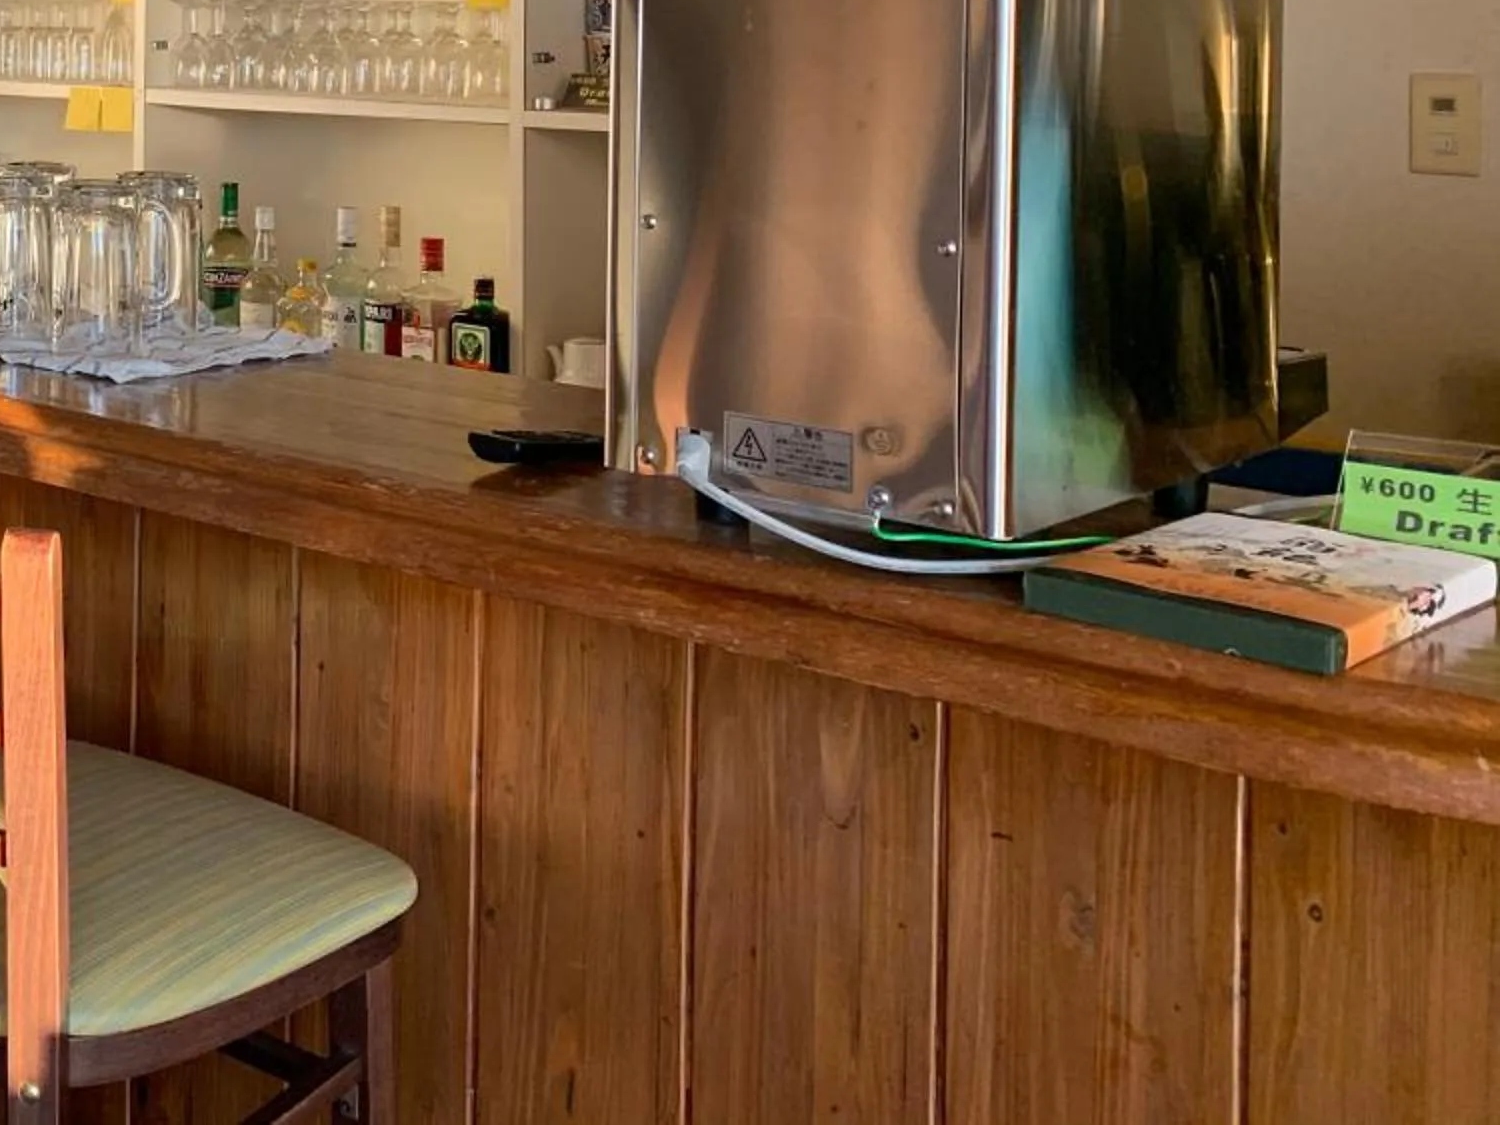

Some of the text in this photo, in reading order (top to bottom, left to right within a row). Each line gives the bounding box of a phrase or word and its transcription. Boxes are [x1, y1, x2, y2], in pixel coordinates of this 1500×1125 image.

[1361, 475, 1493, 516] ¥600 生
[1396, 509, 1500, 546] Draf
